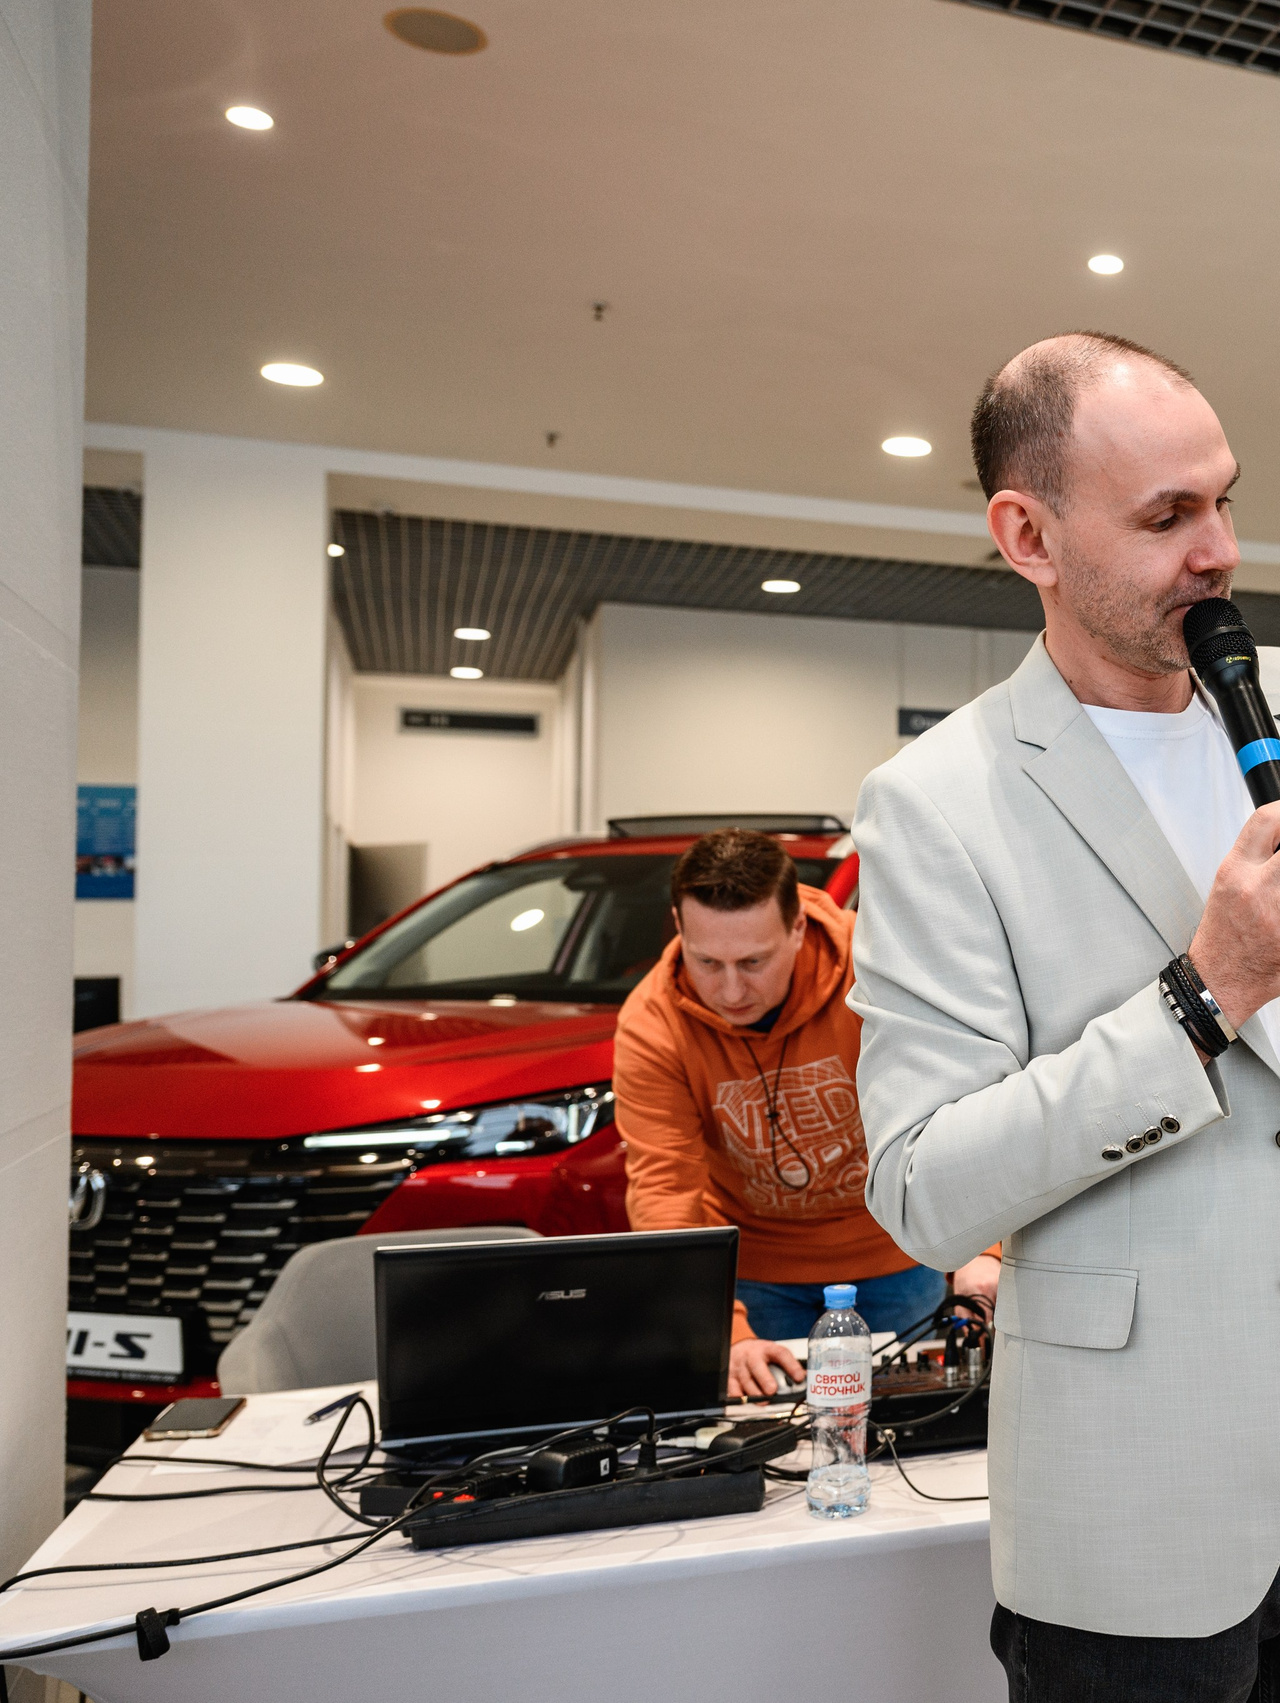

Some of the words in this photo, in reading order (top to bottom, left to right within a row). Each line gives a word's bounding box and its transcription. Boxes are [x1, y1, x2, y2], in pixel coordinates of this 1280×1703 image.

[712, 1079, 861, 1153] NEED
[536, 1288, 587, 1301] ASUS
[67, 1329, 152, 1359] I-S
[815, 1370, 860, 1385] СВЯТОЙ
[810, 1382, 866, 1397] ИСТОЧНИК
